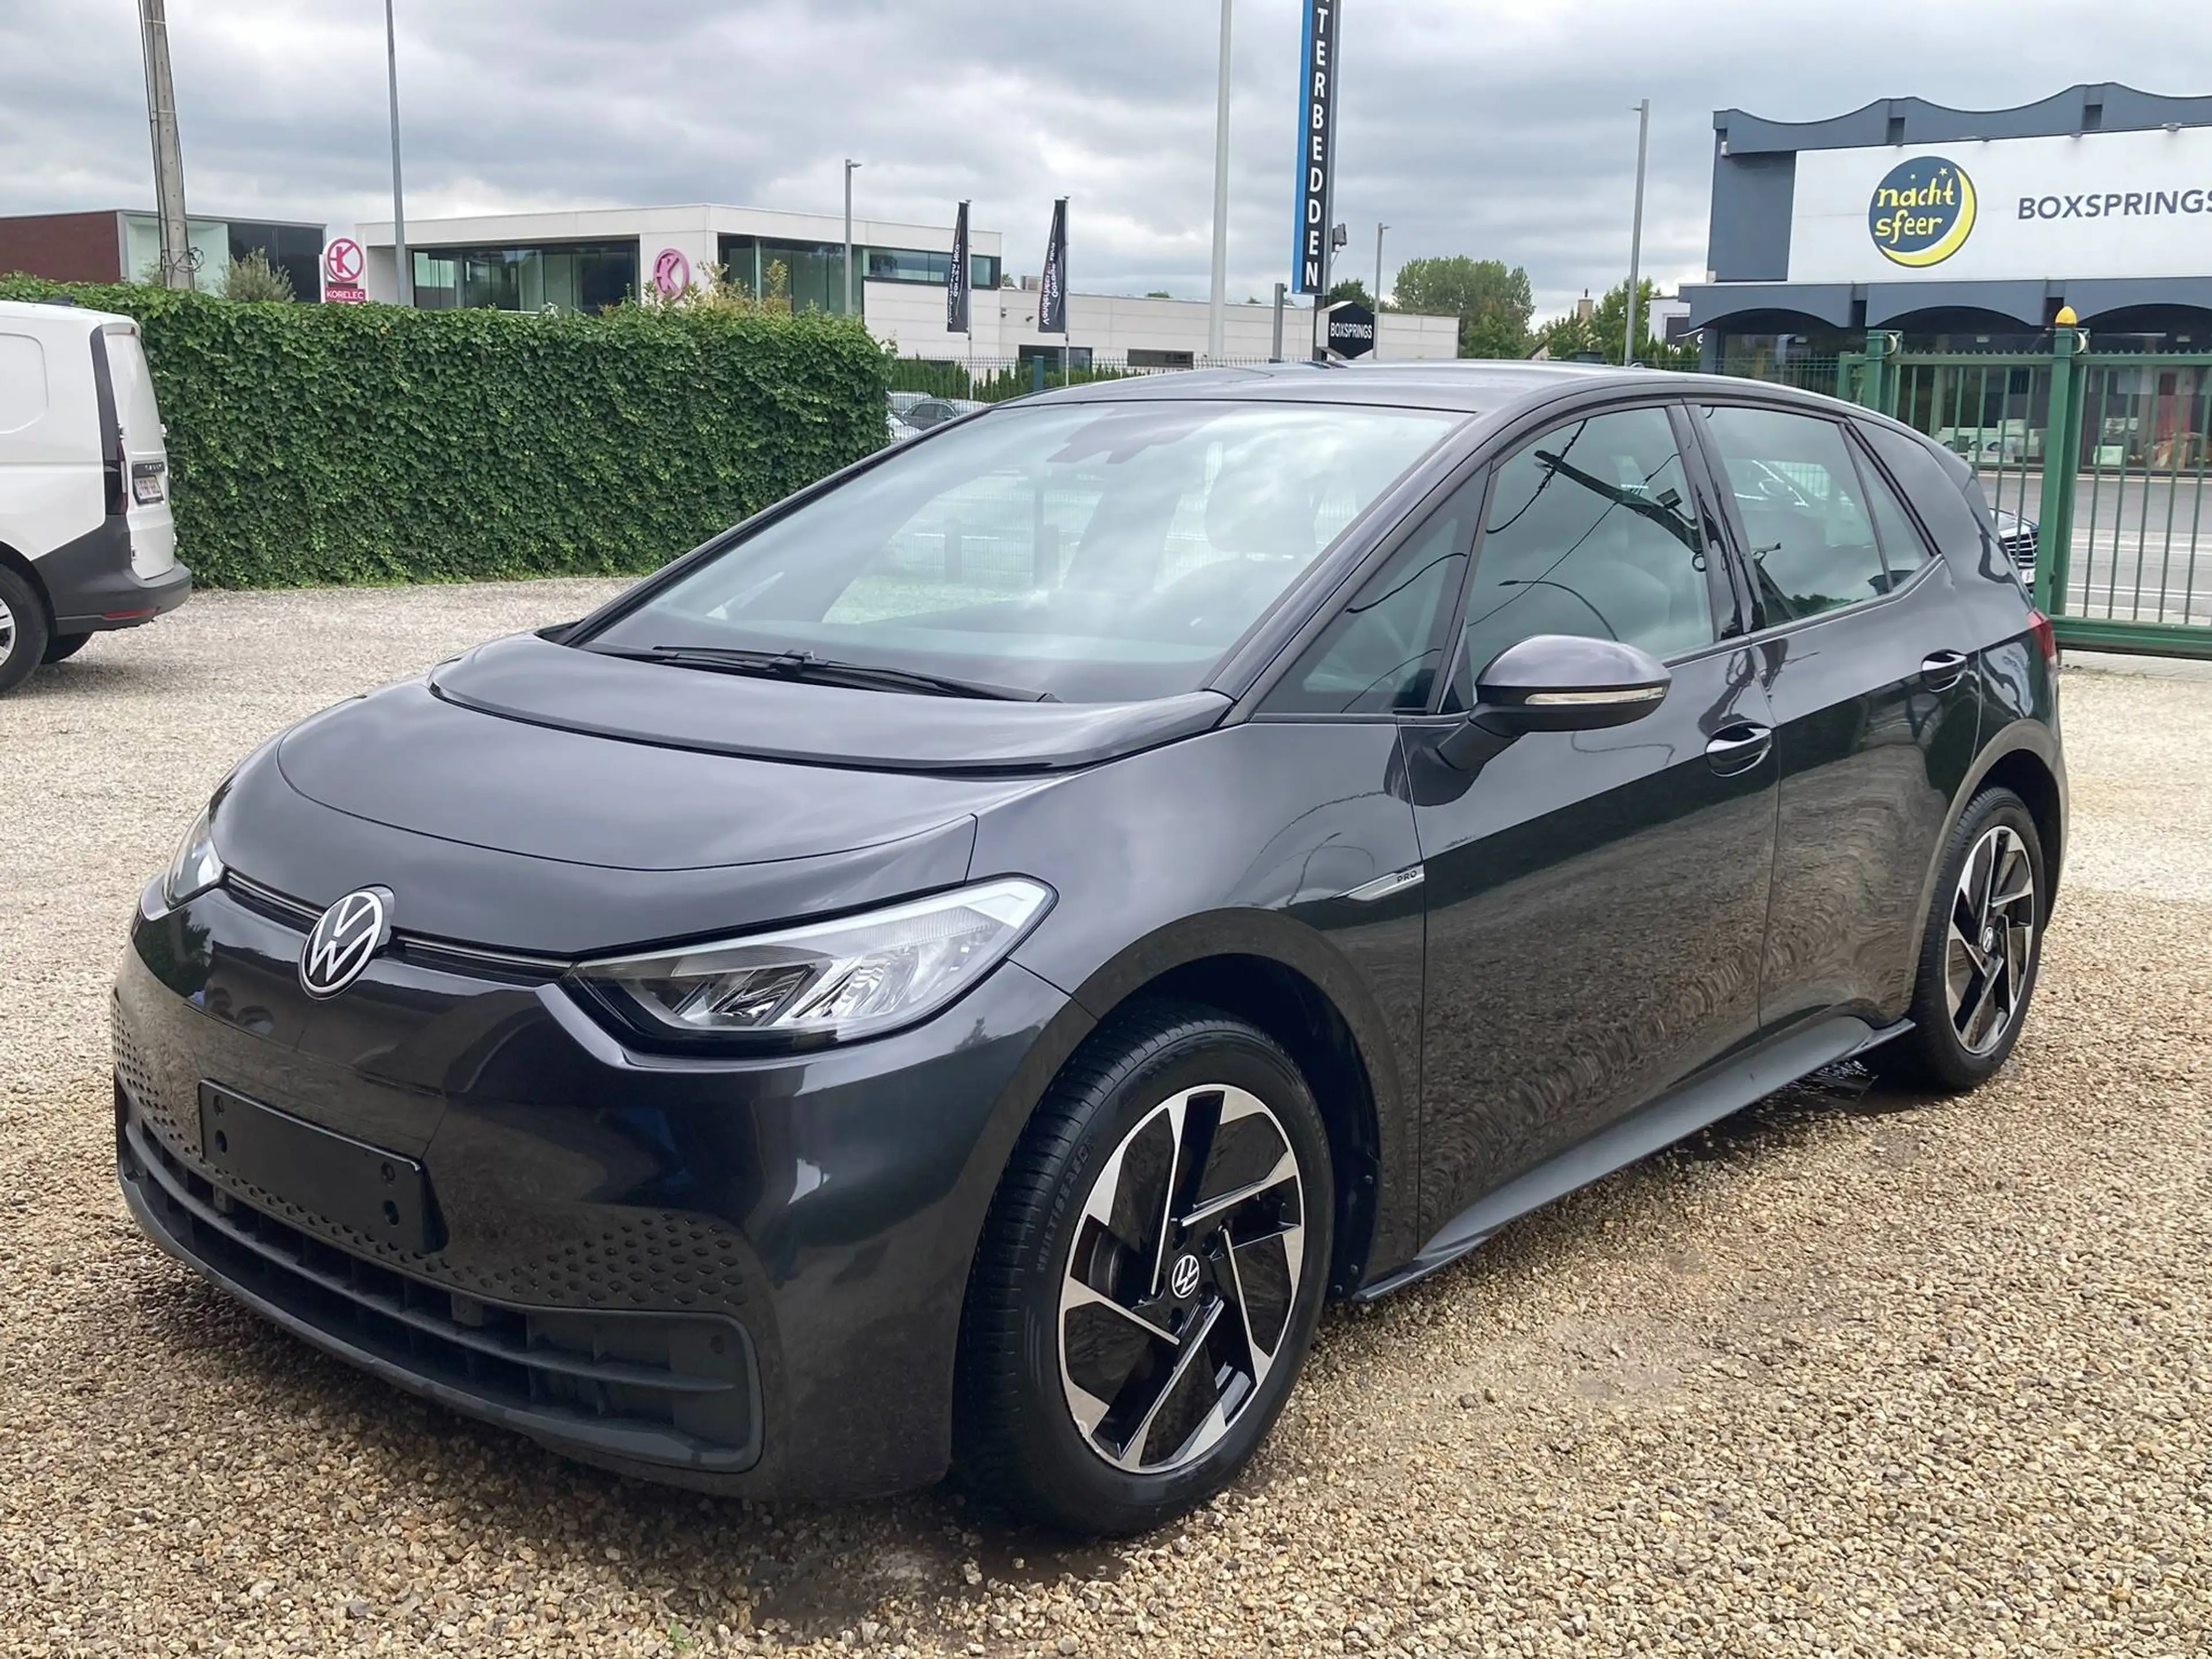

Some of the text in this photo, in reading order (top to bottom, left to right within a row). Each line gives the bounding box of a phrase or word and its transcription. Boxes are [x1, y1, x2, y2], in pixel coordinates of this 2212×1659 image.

[1305, 0, 1330, 286] TERBEDDEN
[1877, 177, 1956, 207] nacht
[1875, 209, 1943, 244] sfeer
[327, 290, 364, 300] KORELEC
[1331, 322, 1373, 339] BOXSPRINGS
[1396, 870, 1417, 882] PRO
[302, 892, 382, 993] VW
